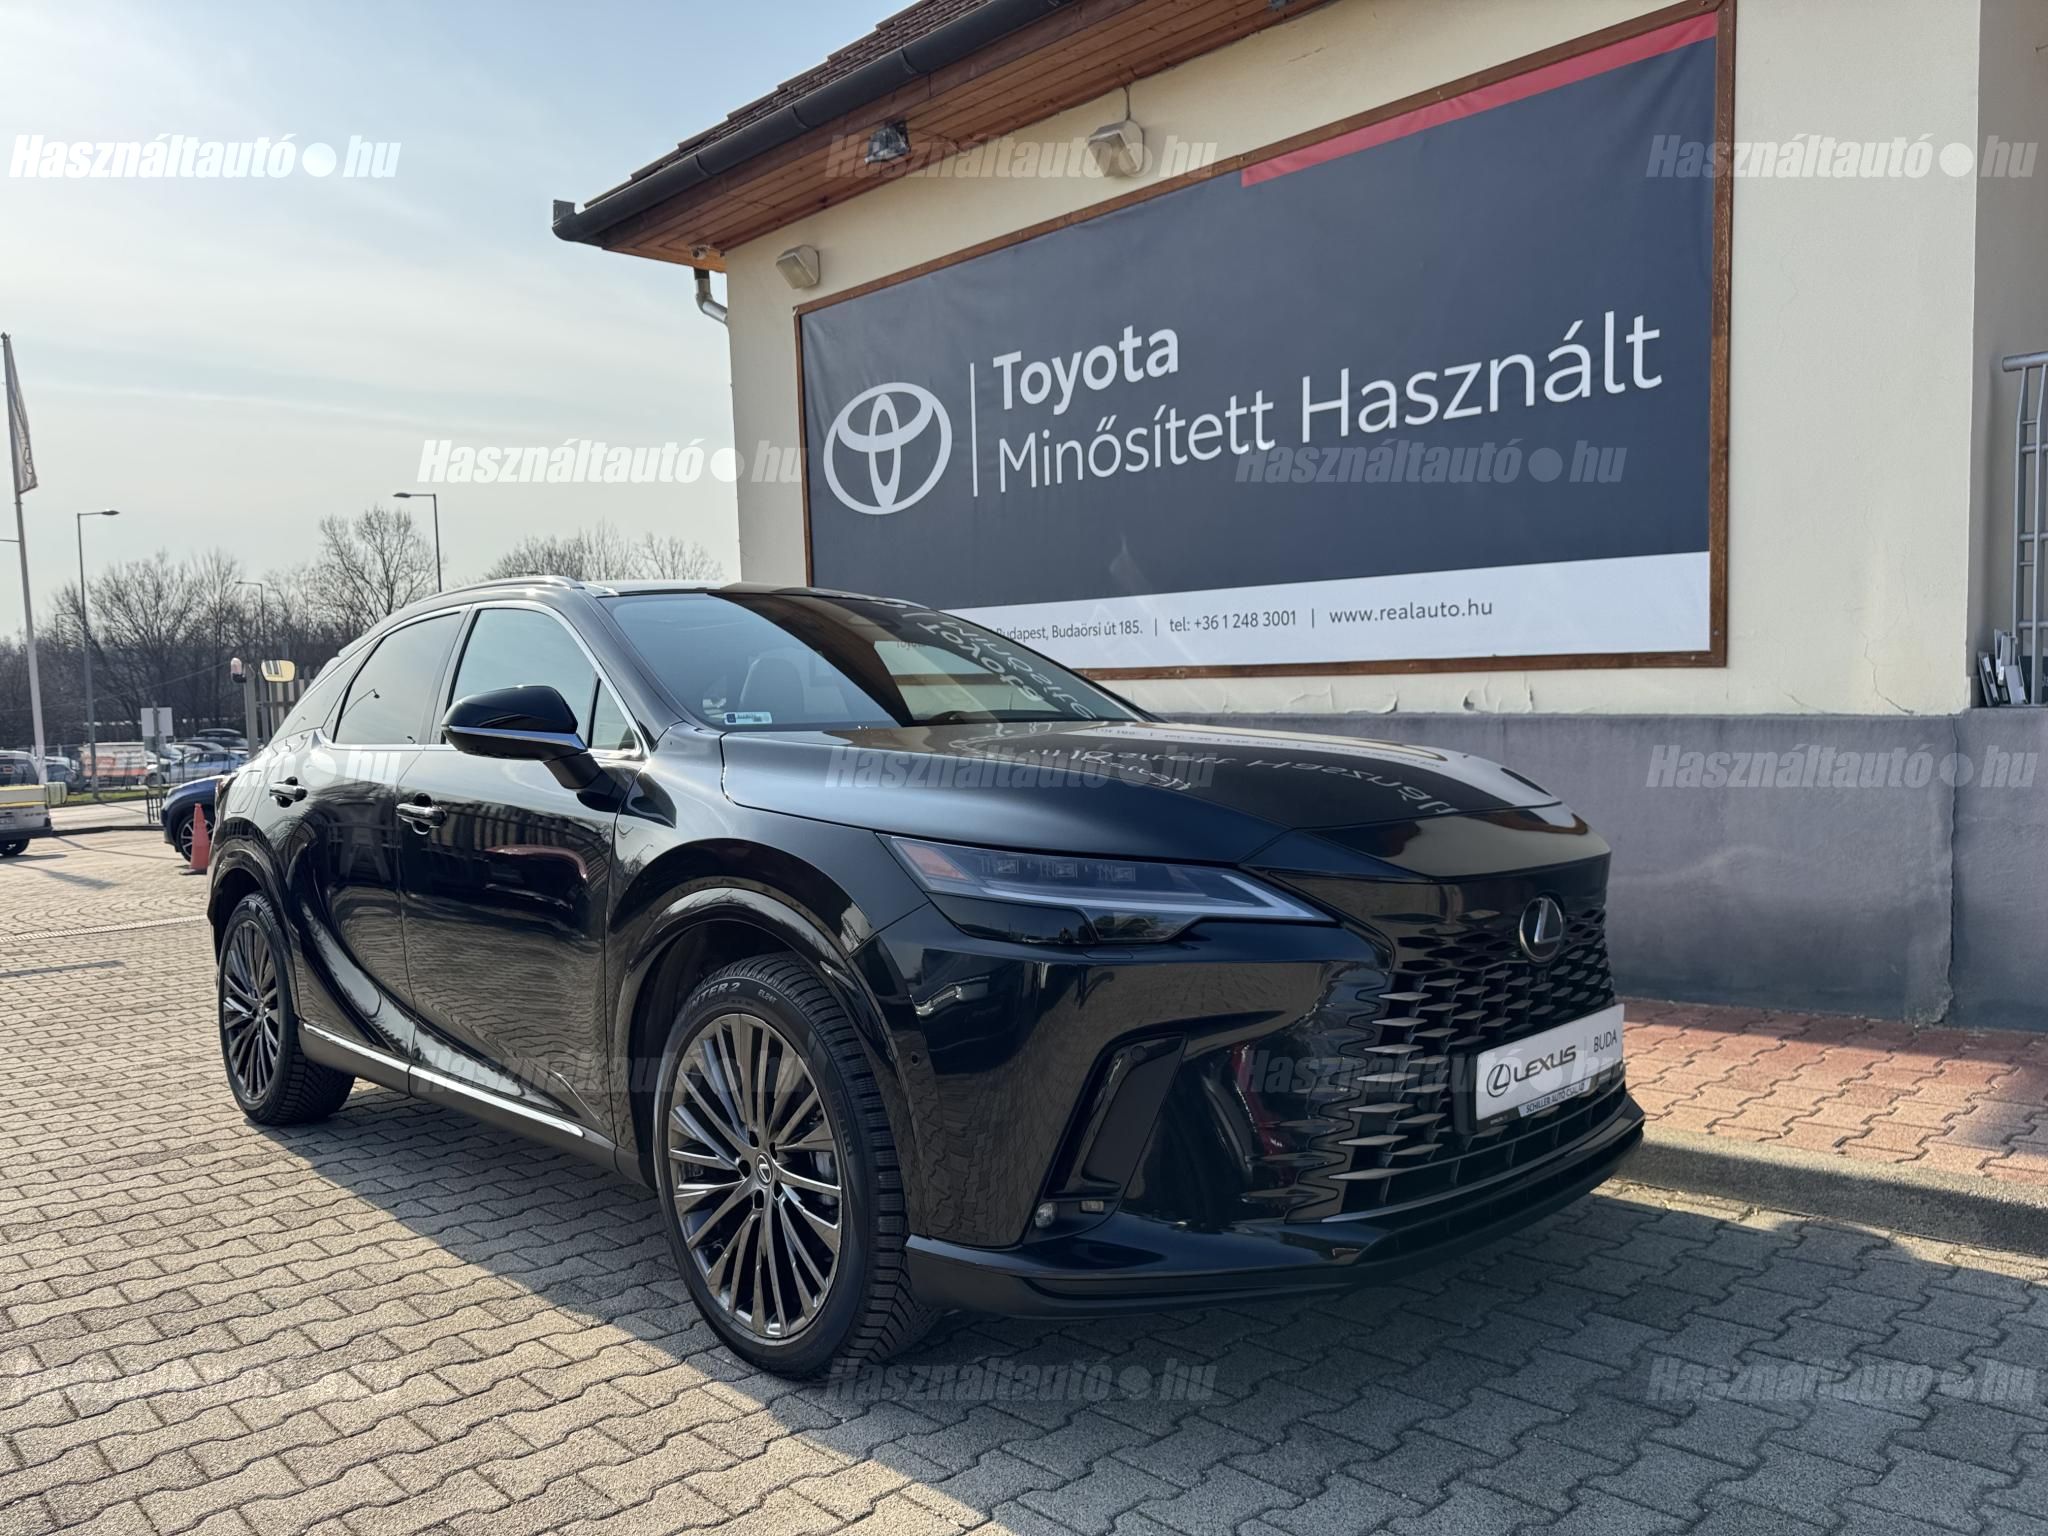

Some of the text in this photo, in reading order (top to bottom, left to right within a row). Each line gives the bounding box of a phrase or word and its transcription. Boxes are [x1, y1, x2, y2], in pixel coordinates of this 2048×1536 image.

[993, 325, 1179, 415] Toyota
[999, 310, 1663, 493] Minősített Használt
[1051, 622, 1101, 639] Budaörsi
[1104, 621, 1117, 636] út
[1119, 619, 1143, 635] 185.
[1169, 616, 1191, 632] tel:
[1232, 612, 1260, 629] 248
[1263, 610, 1297, 627] 3001
[1328, 599, 1493, 624] www.realauto.hu
[1514, 1028, 1618, 1082] LEXUS BUDA
